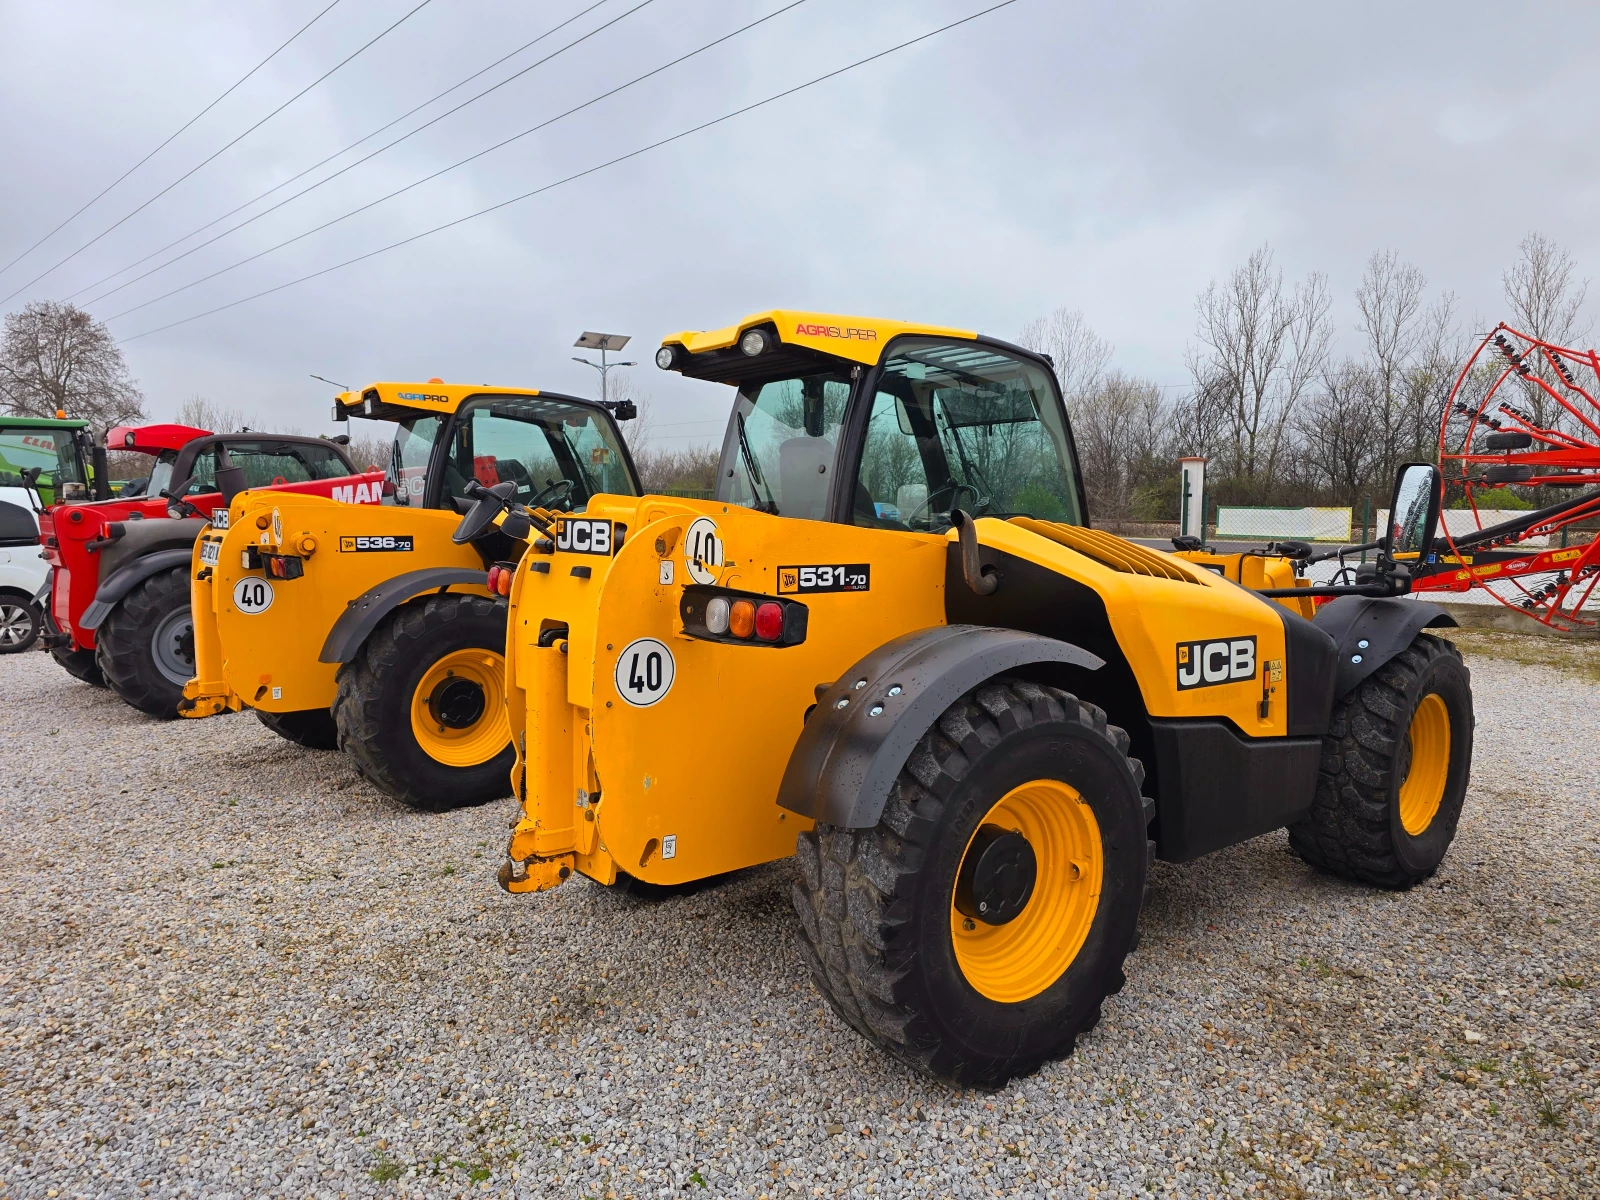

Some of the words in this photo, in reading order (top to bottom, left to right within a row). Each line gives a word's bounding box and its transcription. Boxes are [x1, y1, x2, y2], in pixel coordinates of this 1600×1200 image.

[796, 323, 877, 341] AGRISUPER
[212, 510, 229, 528] JCB
[557, 520, 610, 552] JCB
[693, 531, 715, 572] 40
[241, 584, 265, 607] 40
[628, 651, 662, 693] 40
[1178, 640, 1255, 686] JCB
